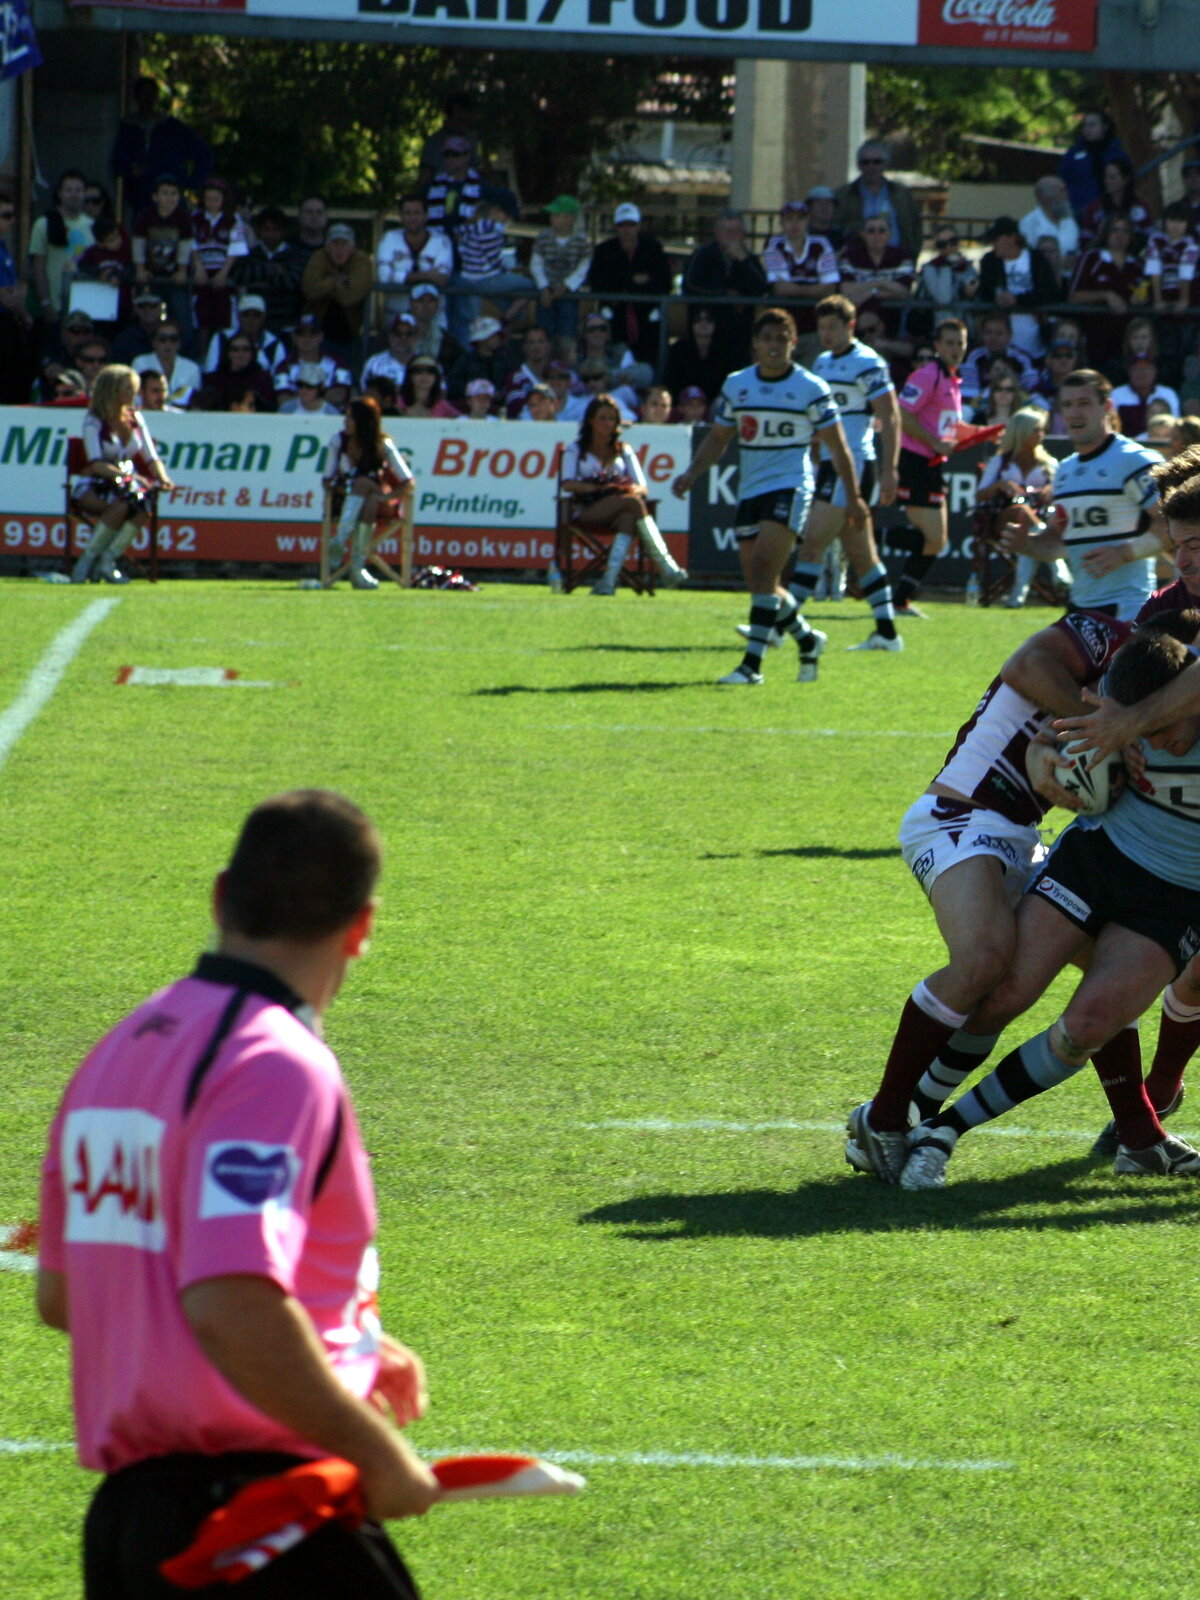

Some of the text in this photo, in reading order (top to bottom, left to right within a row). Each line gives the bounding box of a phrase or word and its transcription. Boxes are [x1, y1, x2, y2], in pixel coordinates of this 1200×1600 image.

[764, 421, 795, 437] LG
[169, 486, 526, 518] First & Last Printing.
[1072, 506, 1109, 528] LG
[1051, 886, 1089, 918] Tyrepower
